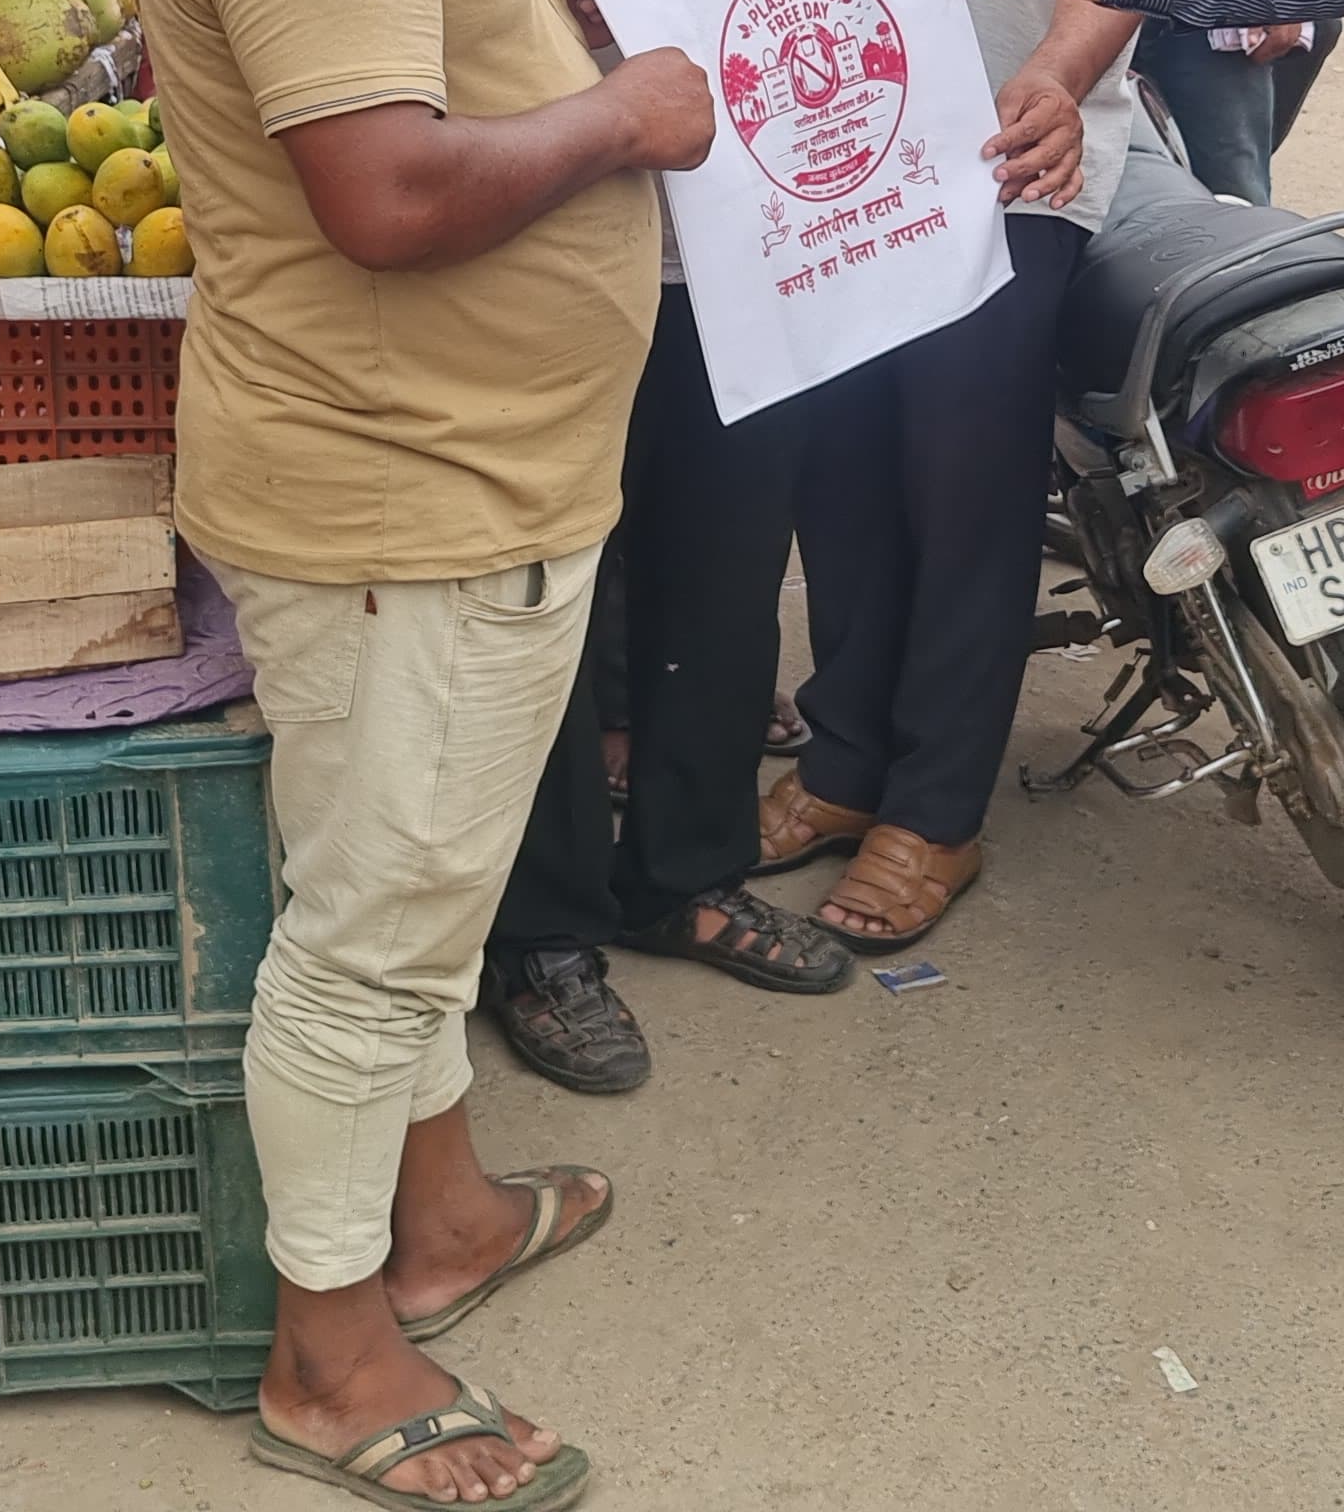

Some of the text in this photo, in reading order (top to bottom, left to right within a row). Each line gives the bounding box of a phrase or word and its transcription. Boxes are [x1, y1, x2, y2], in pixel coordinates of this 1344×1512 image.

[766, 2, 830, 38] FREE DAY
[845, 64, 856, 73] TO
[791, 116, 869, 155] नगर पालिका परिषद
[807, 138, 857, 169] शिकारपुर
[862, 185, 905, 224] हटायें
[776, 205, 949, 298] कपड़े का थैला अपनायें
[1282, 575, 1309, 595] IND
